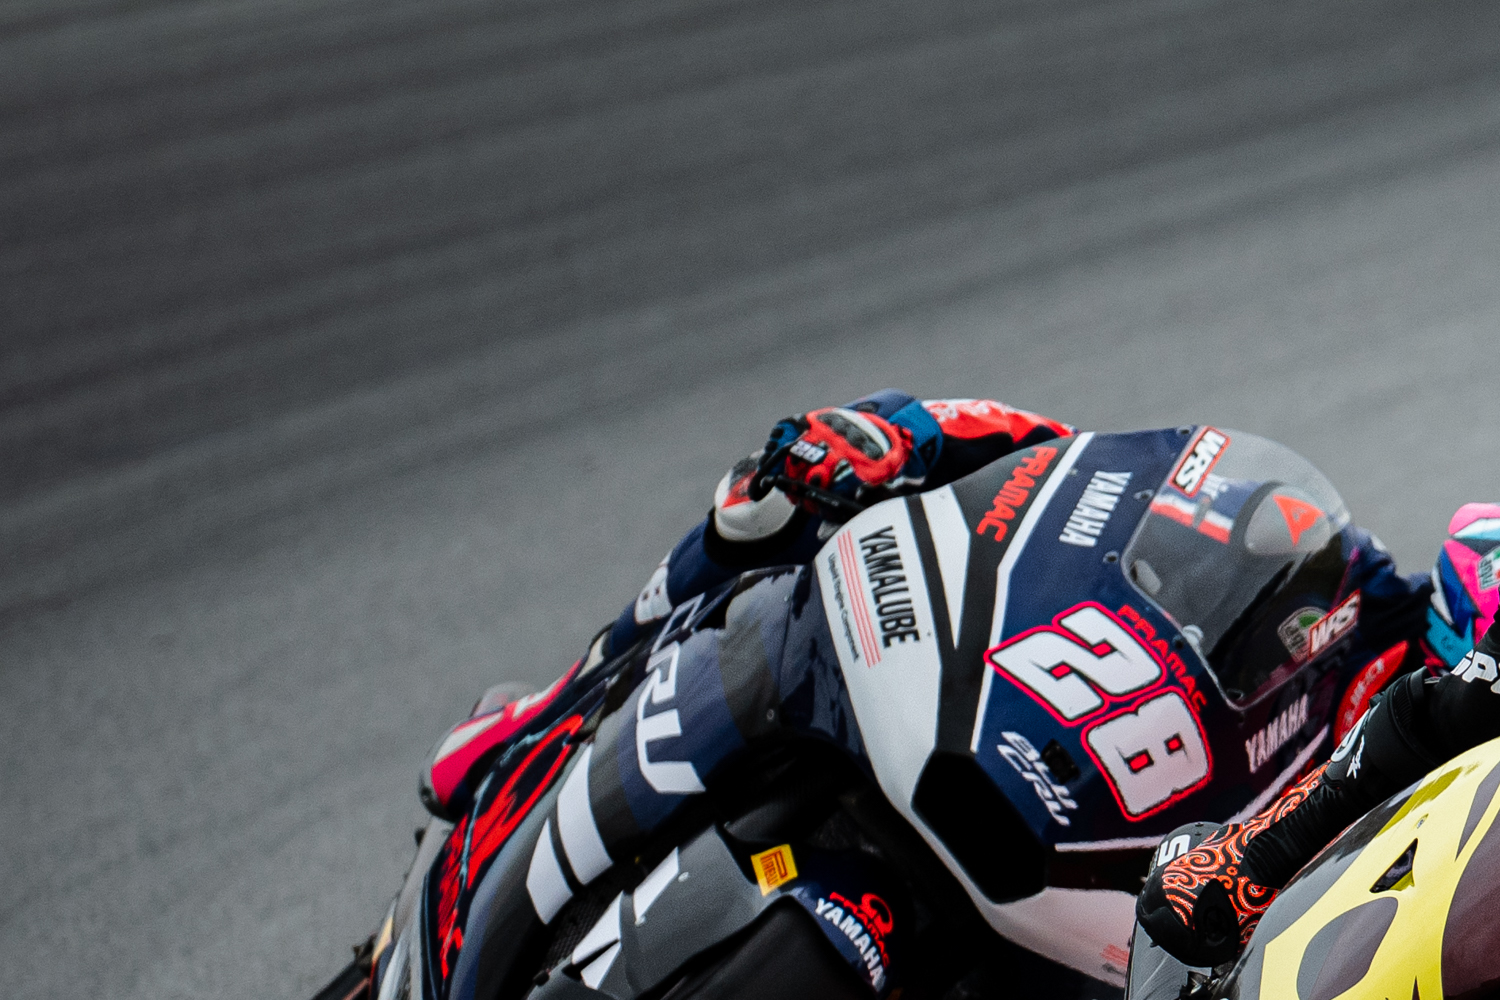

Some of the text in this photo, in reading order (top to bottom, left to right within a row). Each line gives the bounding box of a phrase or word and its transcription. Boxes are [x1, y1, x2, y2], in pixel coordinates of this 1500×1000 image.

[976, 446, 1058, 542] PRAMAC
[1059, 471, 1132, 547] YAMAHA
[1173, 432, 1226, 494] WRS
[859, 525, 920, 648] YAMALUBE
[1117, 605, 1207, 712] PRAMAC
[984, 602, 1213, 822] 28
[1245, 693, 1308, 774] YAMAHA
[814, 898, 886, 992] YAMAHA
